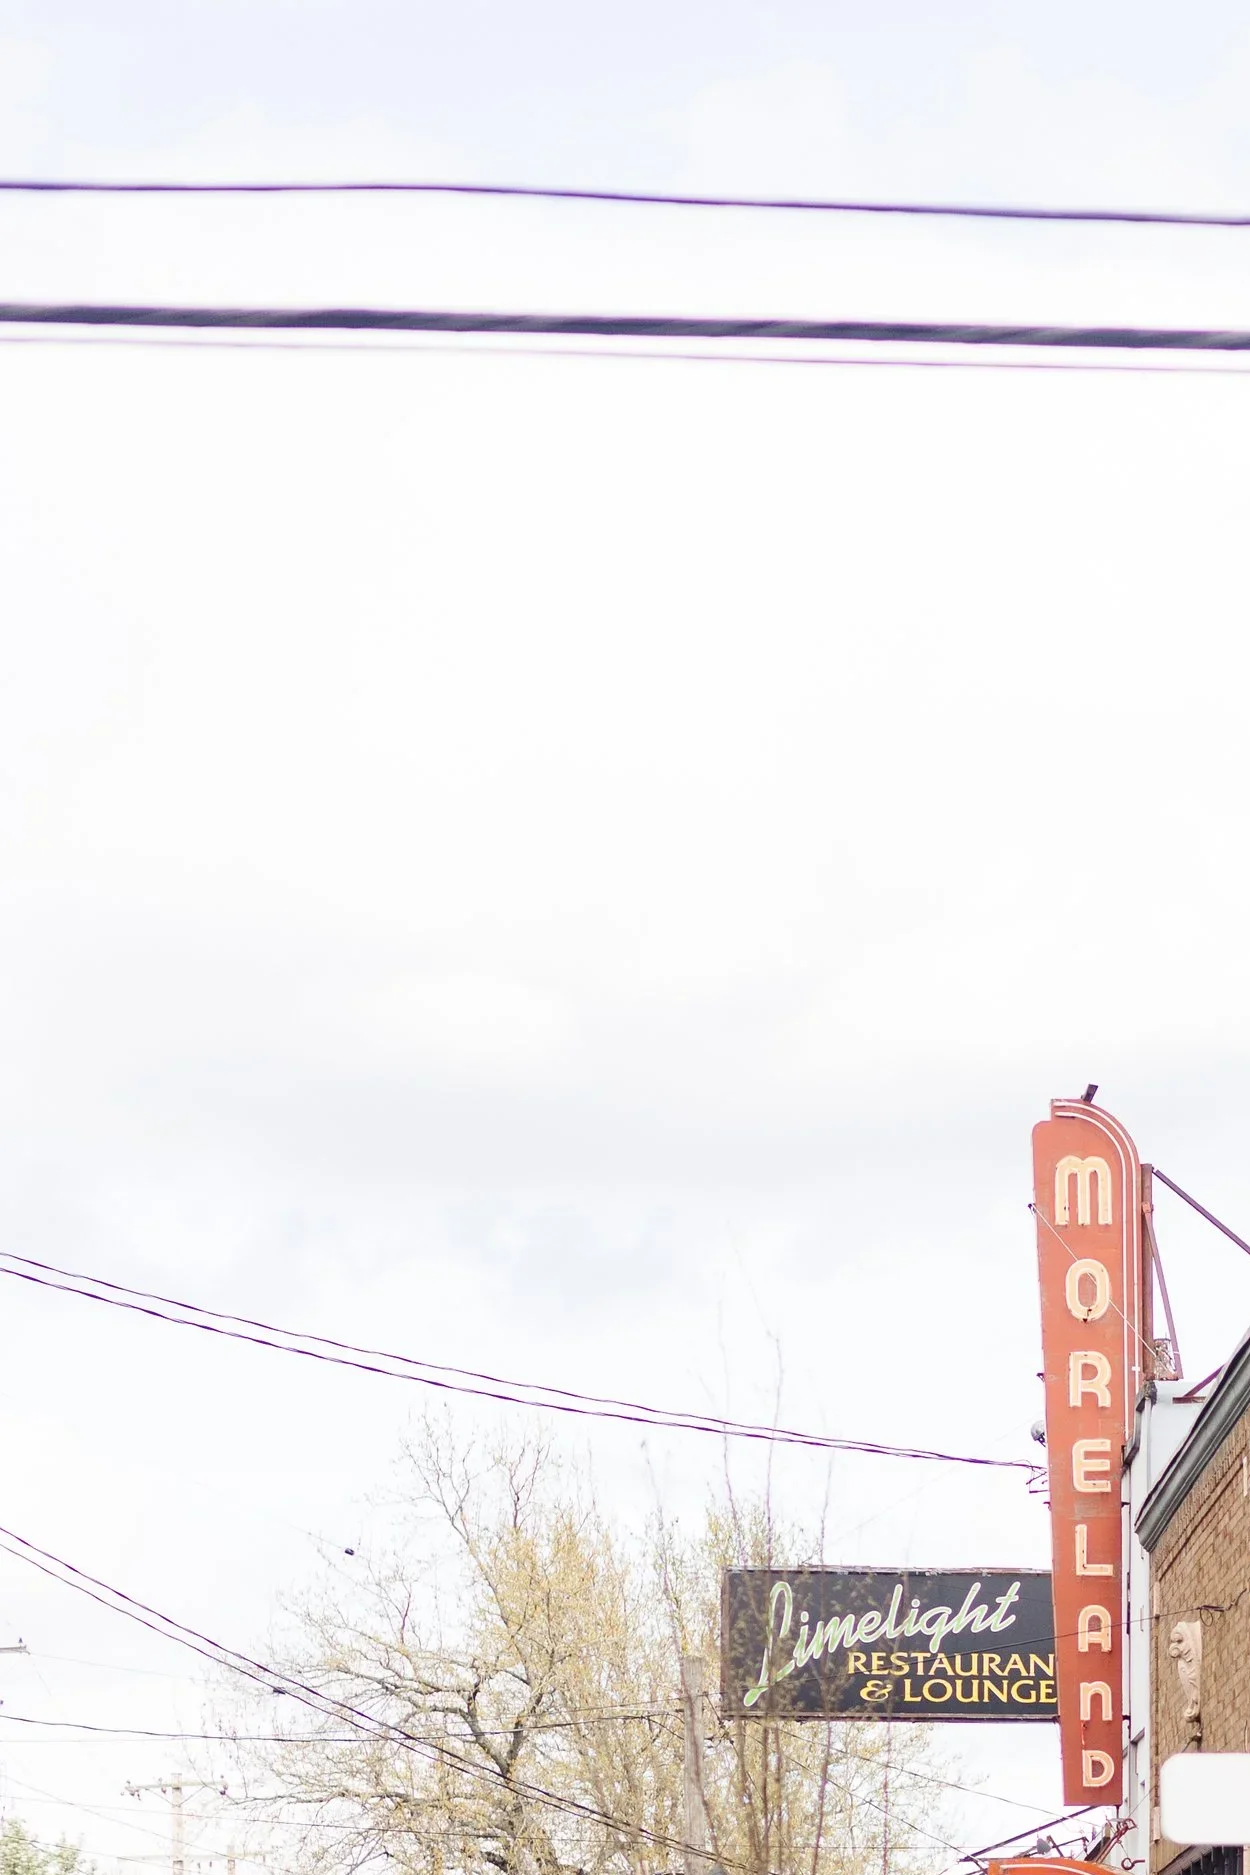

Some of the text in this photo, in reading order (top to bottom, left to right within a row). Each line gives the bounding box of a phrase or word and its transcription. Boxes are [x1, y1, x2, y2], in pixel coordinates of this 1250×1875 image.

[1054, 1155, 1115, 1788] MORELAND
[744, 1581, 1021, 1707] Limelight
[848, 1651, 1056, 1677] RESTAURAN
[860, 1679, 1058, 1704] & LOUNGE
